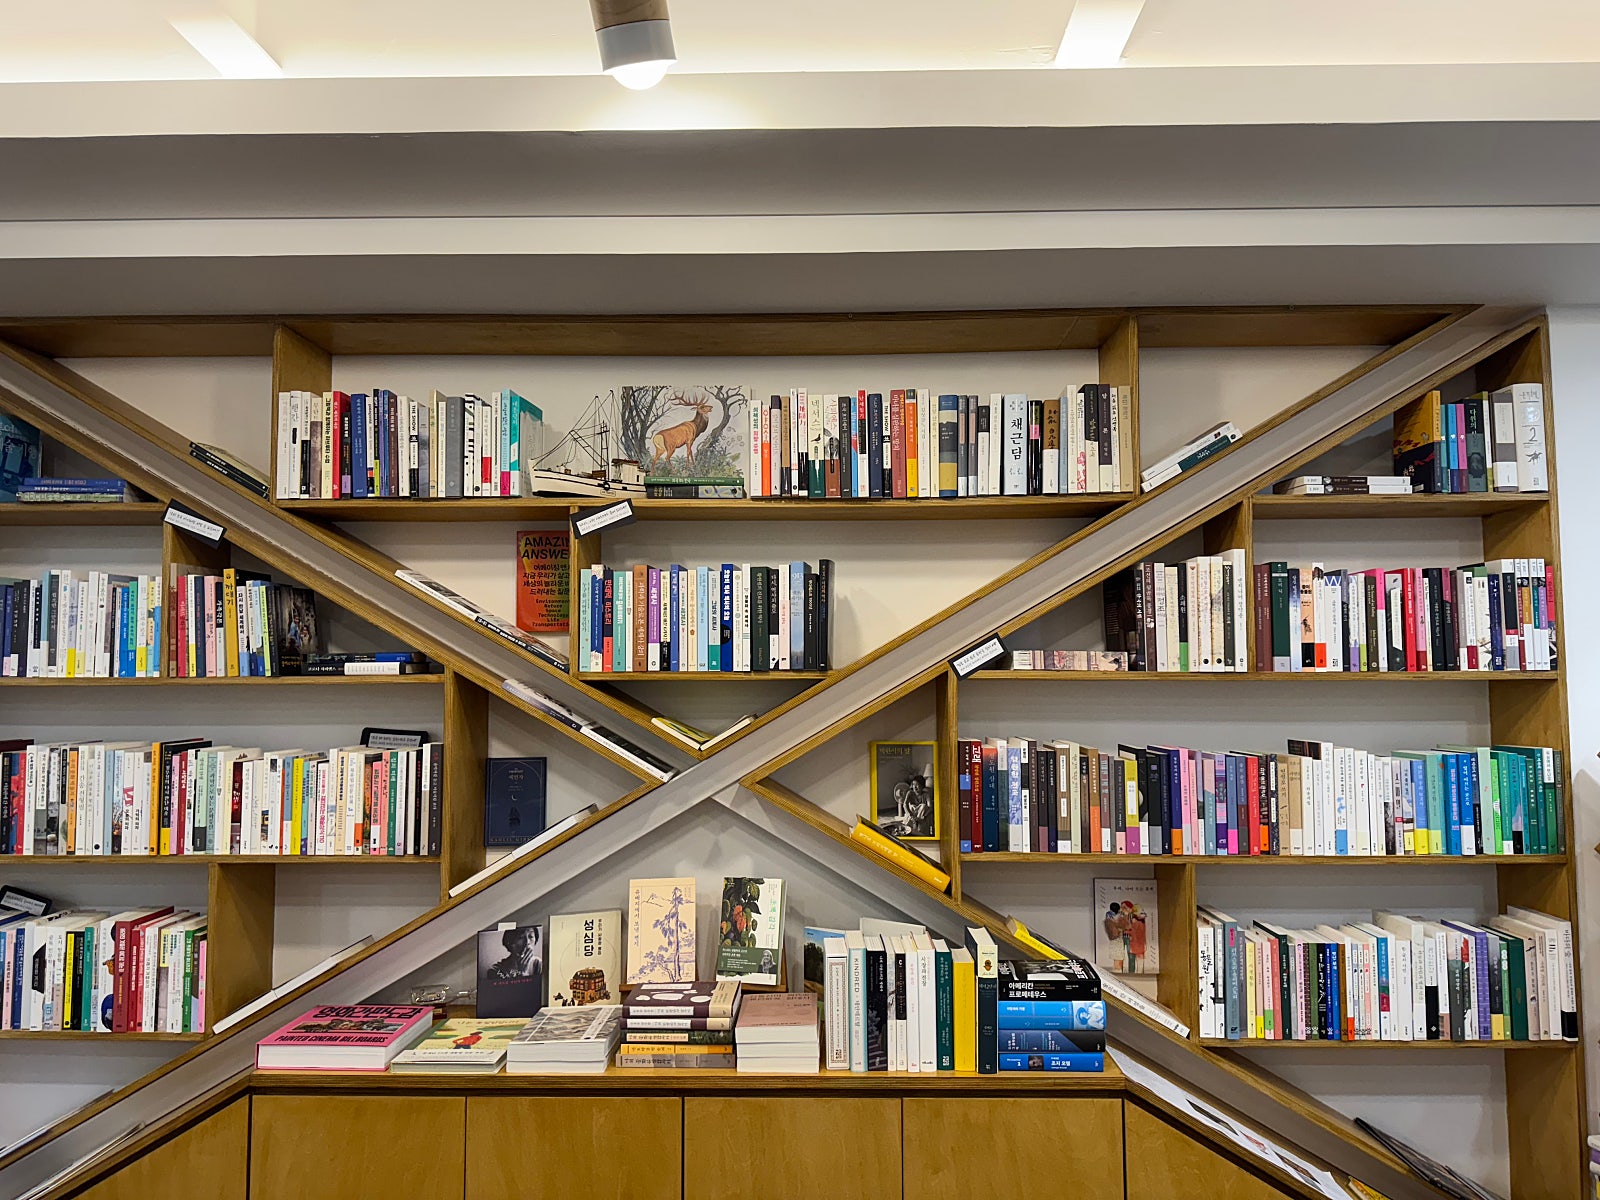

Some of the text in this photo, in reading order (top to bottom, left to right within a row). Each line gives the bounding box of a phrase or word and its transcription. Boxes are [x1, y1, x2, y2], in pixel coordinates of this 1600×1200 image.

[1010, 417, 1024, 460] 채근담
[1529, 427, 1538, 442] 2
[325, 454, 330, 464] 수업
[1325, 576, 1341, 586] W
[225, 583, 234, 606] 까대기
[724, 584, 730, 594] 역사
[724, 611, 730, 621] 오늘
[637, 644, 645, 655] 강의
[972, 745, 981, 763] 고래
[391, 770, 396, 782] 미래
[584, 919, 594, 957] 성심당
[1008, 990, 1047, 998] 프로메테우스
[312, 1006, 424, 1018] 영화간판도감
